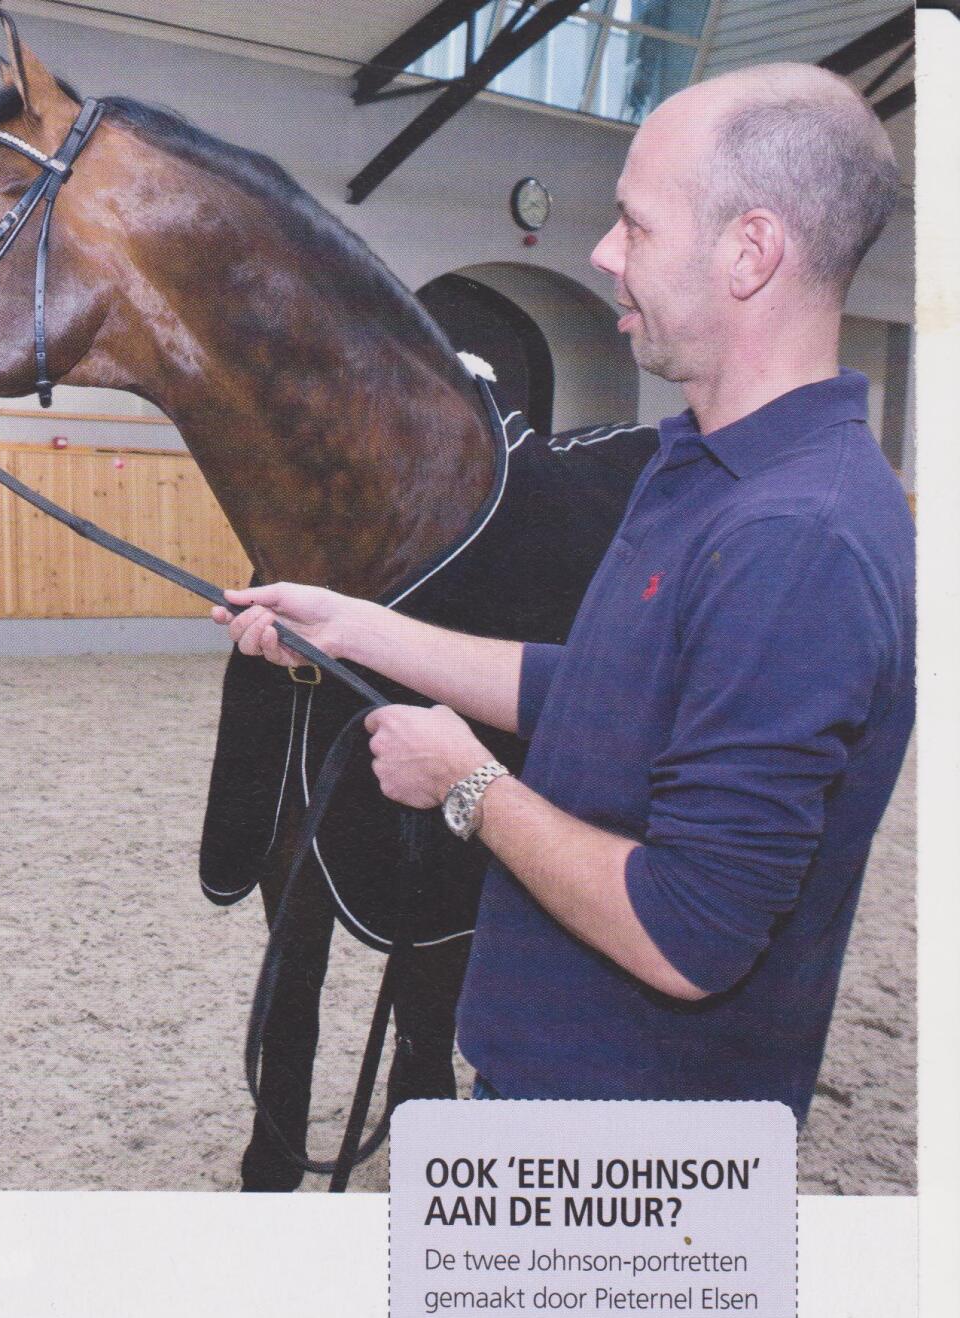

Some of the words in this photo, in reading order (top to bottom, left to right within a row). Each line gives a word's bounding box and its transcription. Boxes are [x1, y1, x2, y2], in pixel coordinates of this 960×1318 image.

[426, 1158, 498, 1188] OOK
[424, 1196, 496, 1226] AAN
[510, 1196, 551, 1226] DE
[565, 1197, 682, 1227] MUUR?
[426, 1249, 455, 1270] De
[463, 1251, 520, 1271] twee
[528, 1248, 747, 1277] Johnson-portretten
[425, 1286, 525, 1313] gemaakt
[533, 1286, 587, 1309] door
[596, 1287, 692, 1309] Pieternel
[702, 1287, 757, 1310] Elsen
